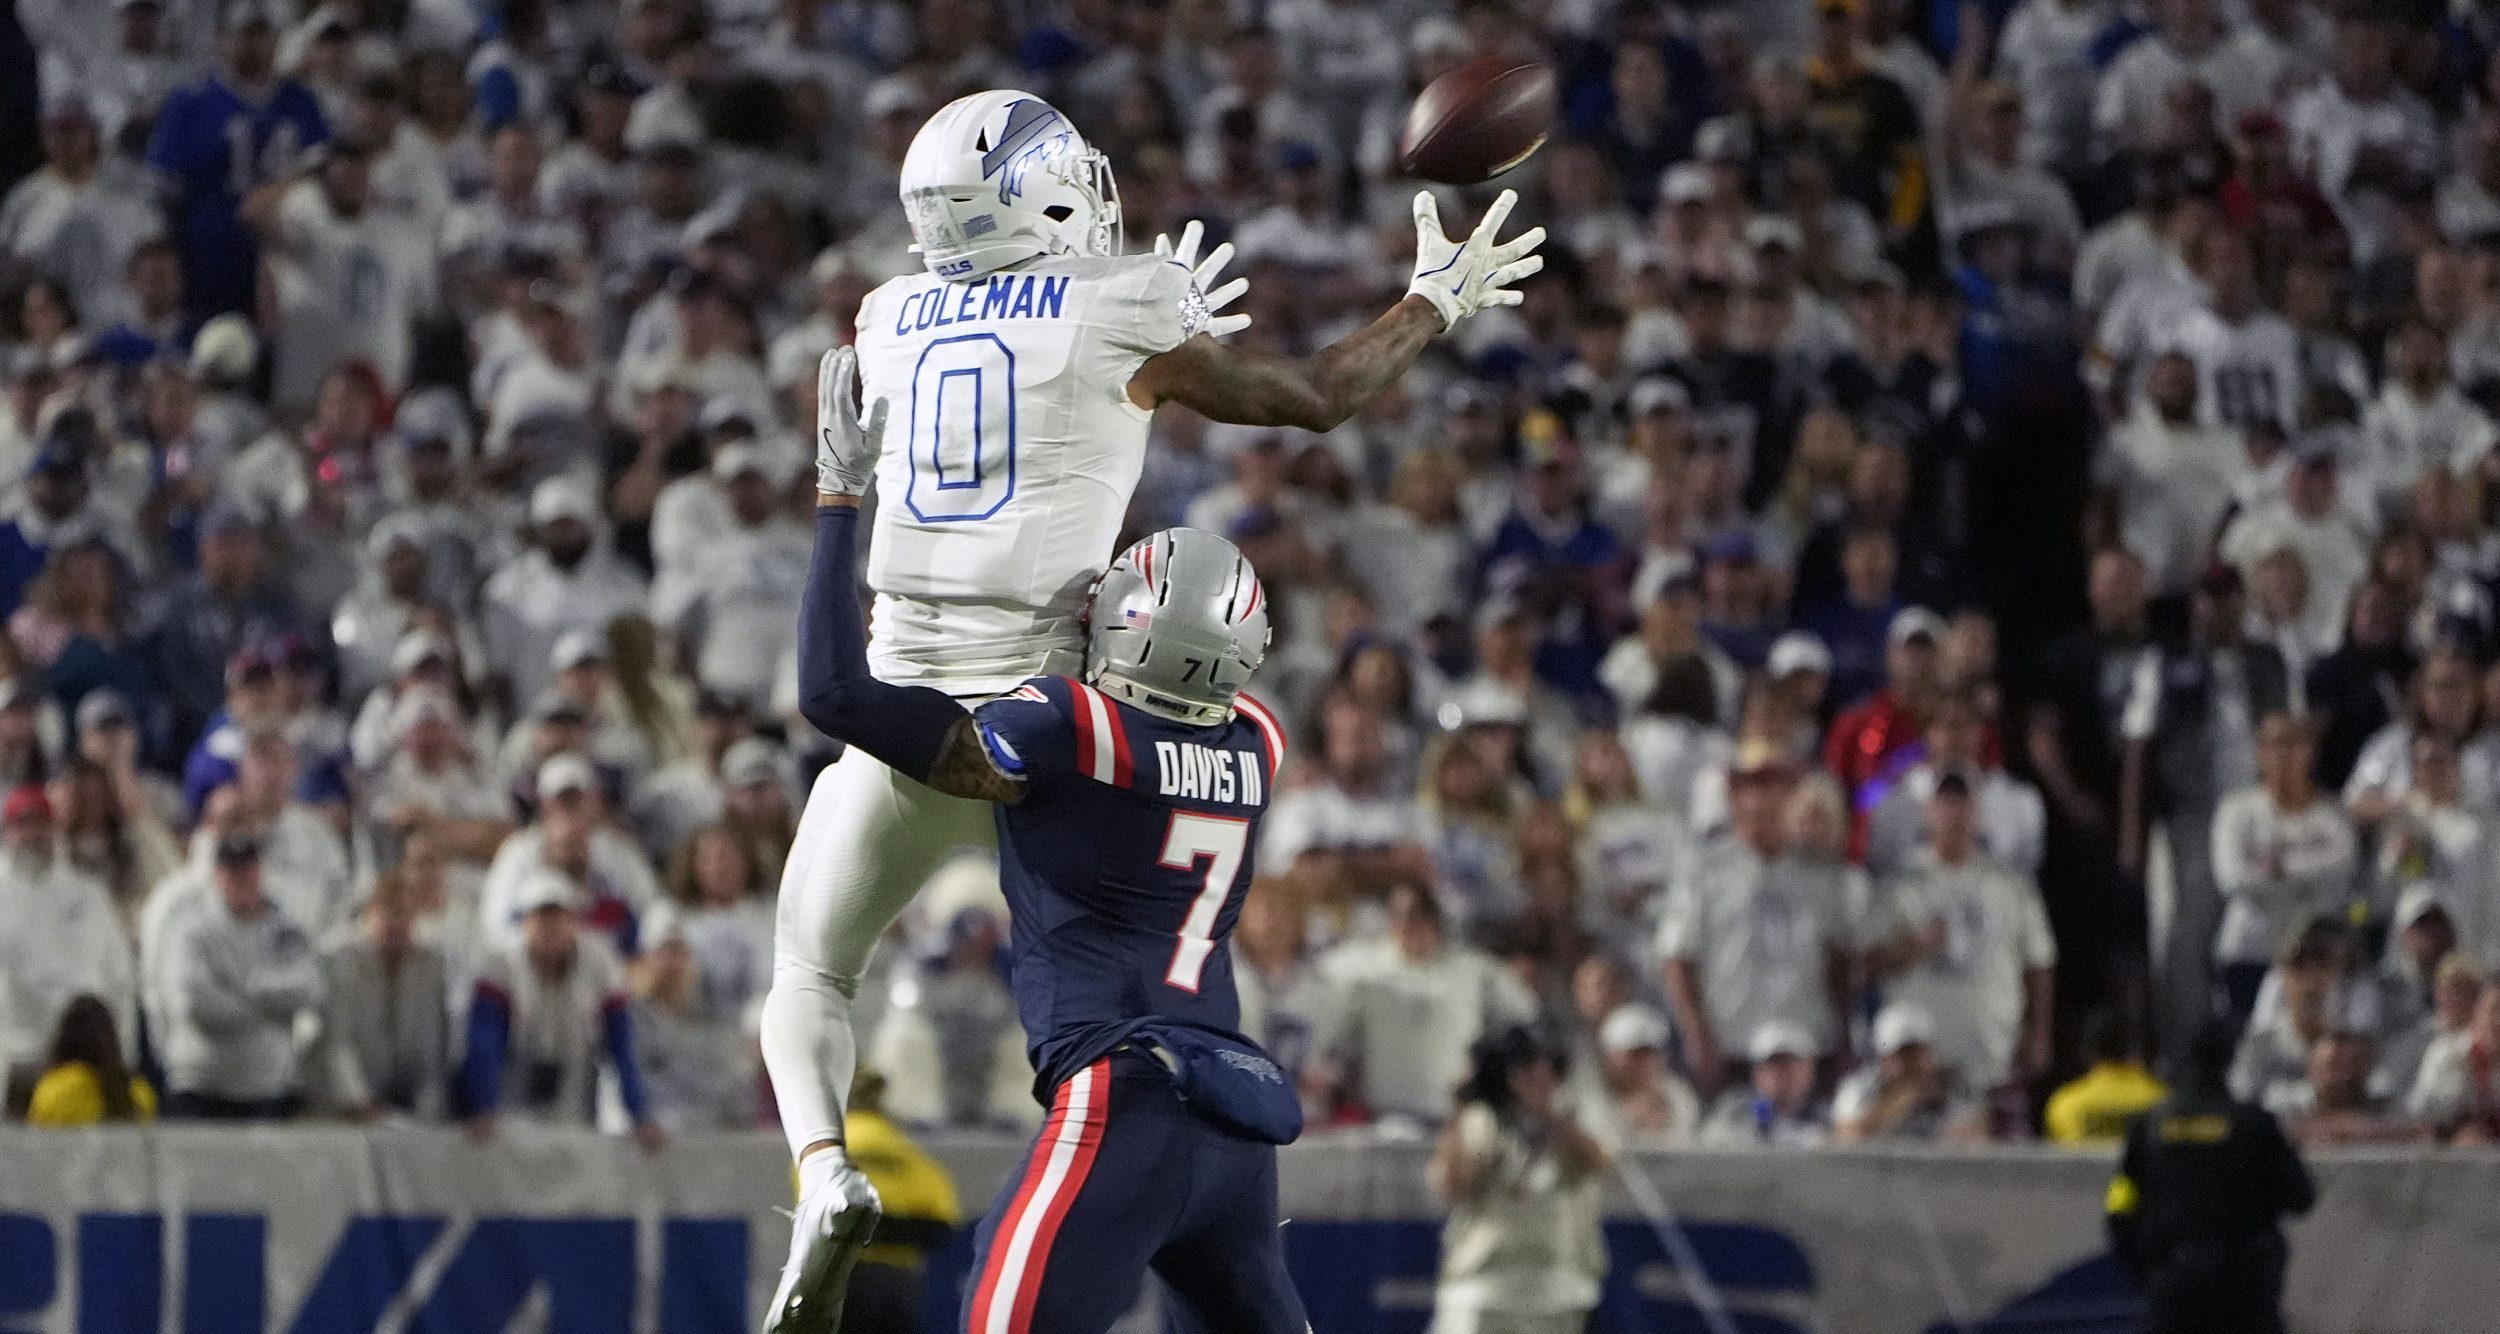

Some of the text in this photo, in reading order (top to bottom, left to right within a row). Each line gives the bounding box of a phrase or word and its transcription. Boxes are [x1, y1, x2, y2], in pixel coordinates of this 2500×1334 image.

[896, 275, 1071, 336] COLEMAN
[905, 332, 1016, 523] 0
[1182, 657, 1202, 682] 7
[1155, 741, 1261, 806] DAVIS III
[1156, 808, 1250, 994] 7
